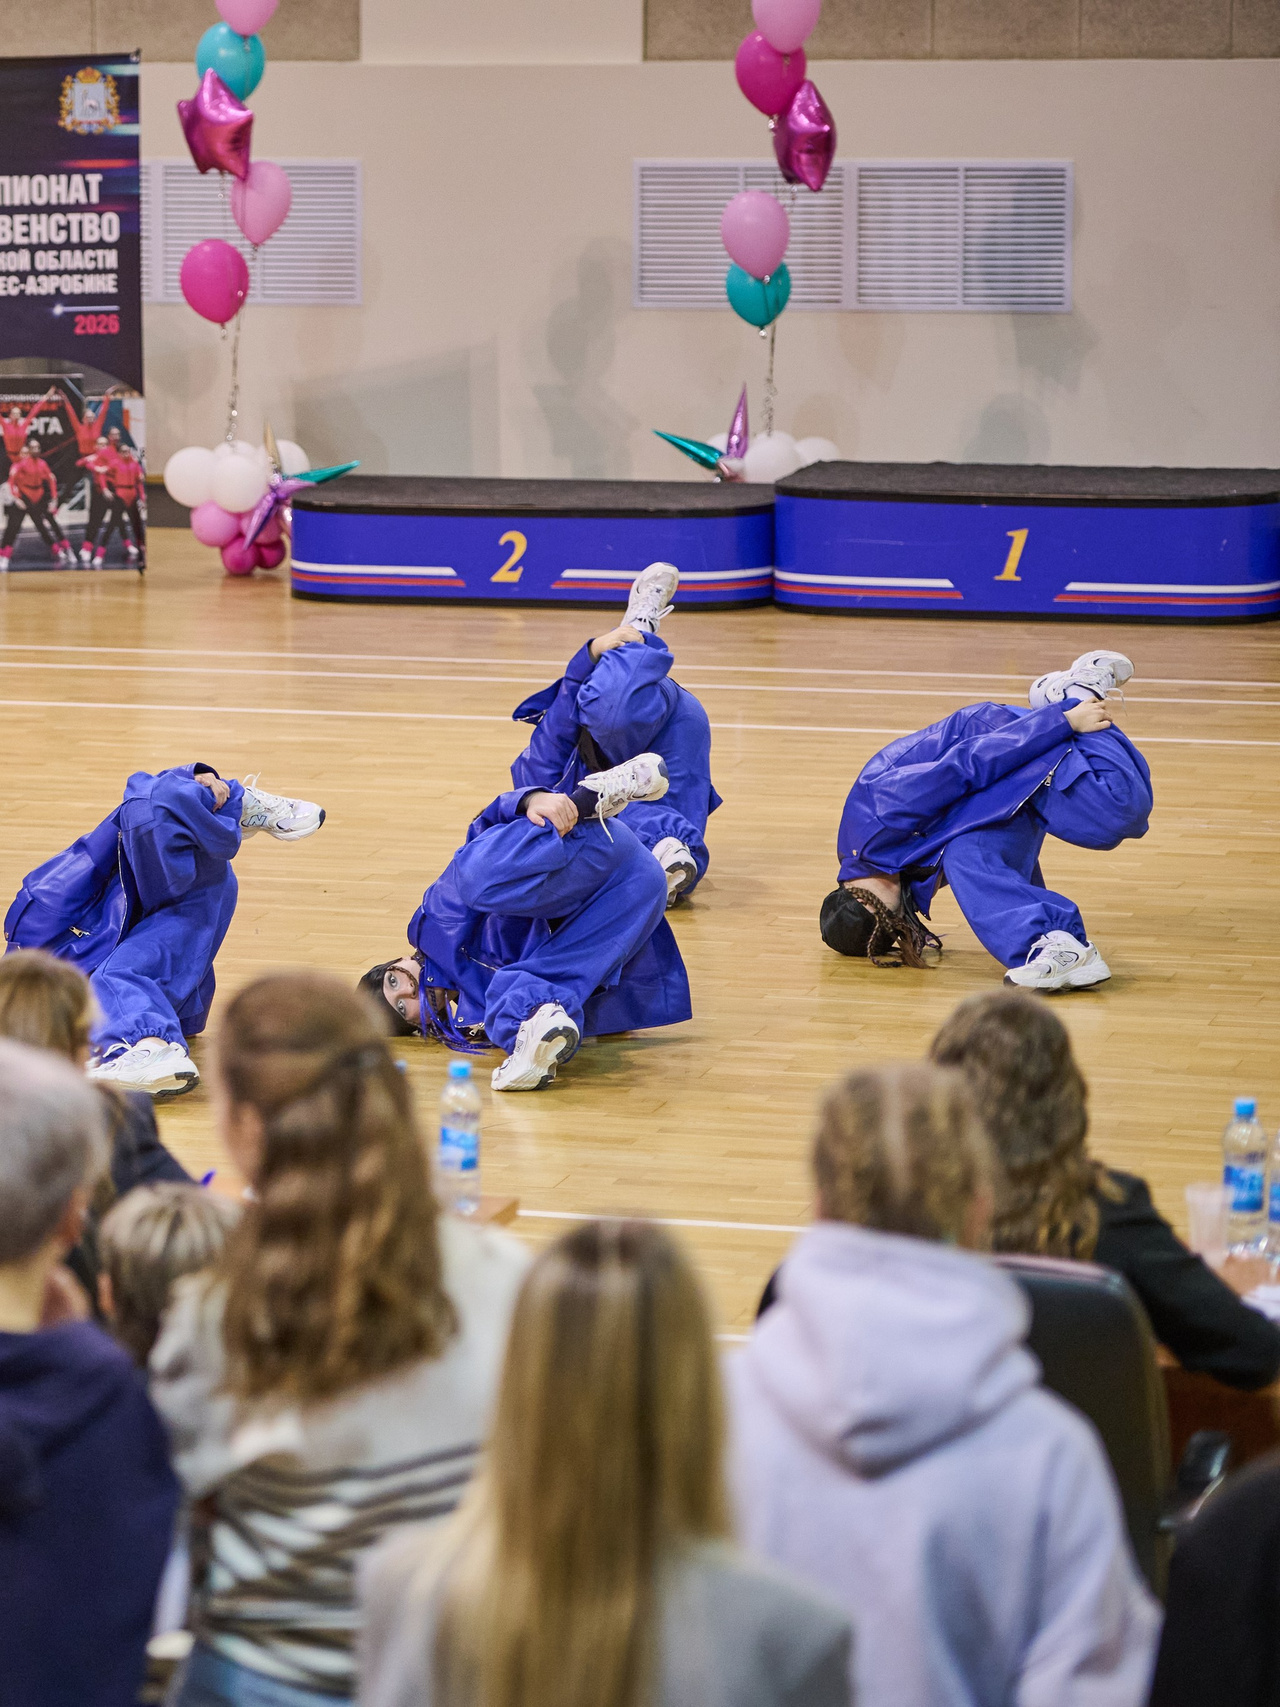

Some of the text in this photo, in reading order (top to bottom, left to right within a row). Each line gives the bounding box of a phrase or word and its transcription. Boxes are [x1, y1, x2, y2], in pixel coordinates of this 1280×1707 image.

[34, 249, 118, 271] ОБЛАСТИ
[73, 314, 120, 335] 2026
[490, 530, 527, 582] 2
[994, 528, 1029, 581] 1
